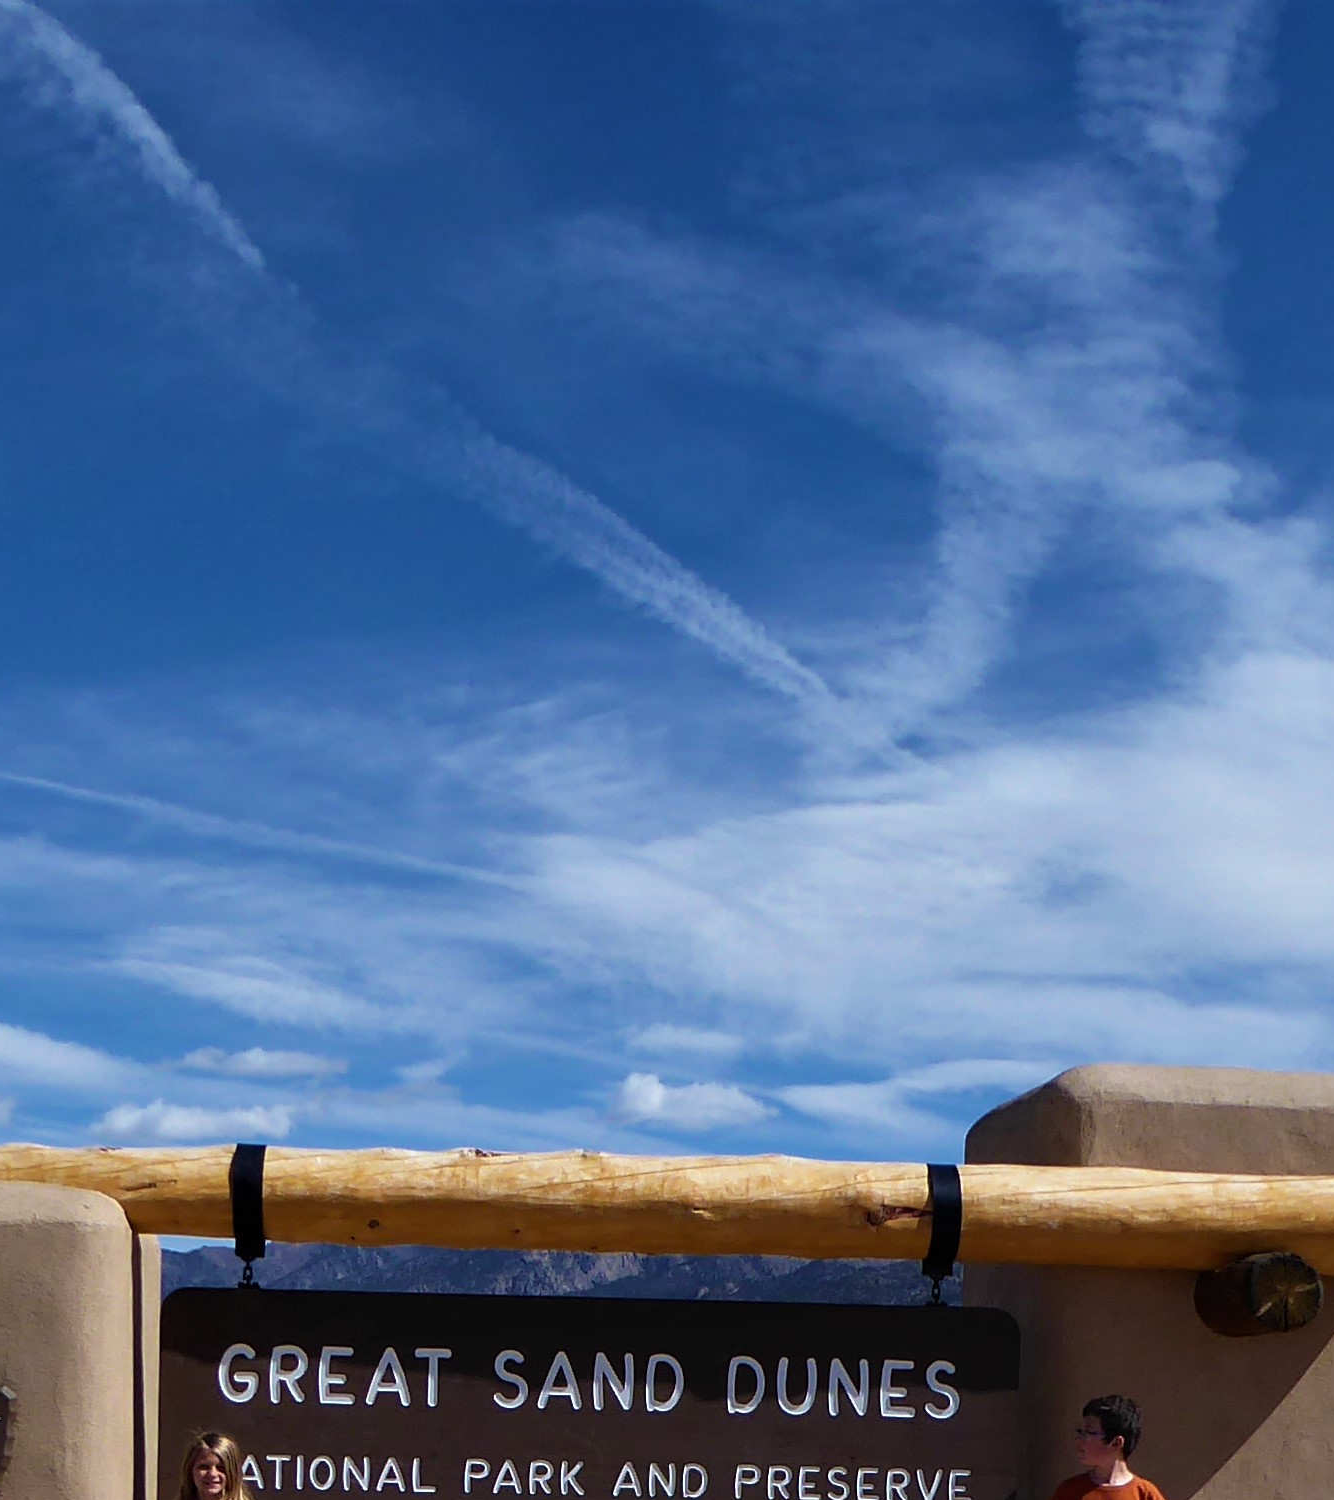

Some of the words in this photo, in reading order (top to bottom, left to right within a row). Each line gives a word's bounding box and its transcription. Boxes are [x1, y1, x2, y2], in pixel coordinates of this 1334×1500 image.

[217, 1343, 452, 1408] GREAT
[493, 1349, 685, 1413] SAND
[726, 1355, 961, 1420] DUNES
[241, 1454, 436, 1495] ATIONAL
[463, 1458, 585, 1497] PARK
[612, 1461, 709, 1499] AND
